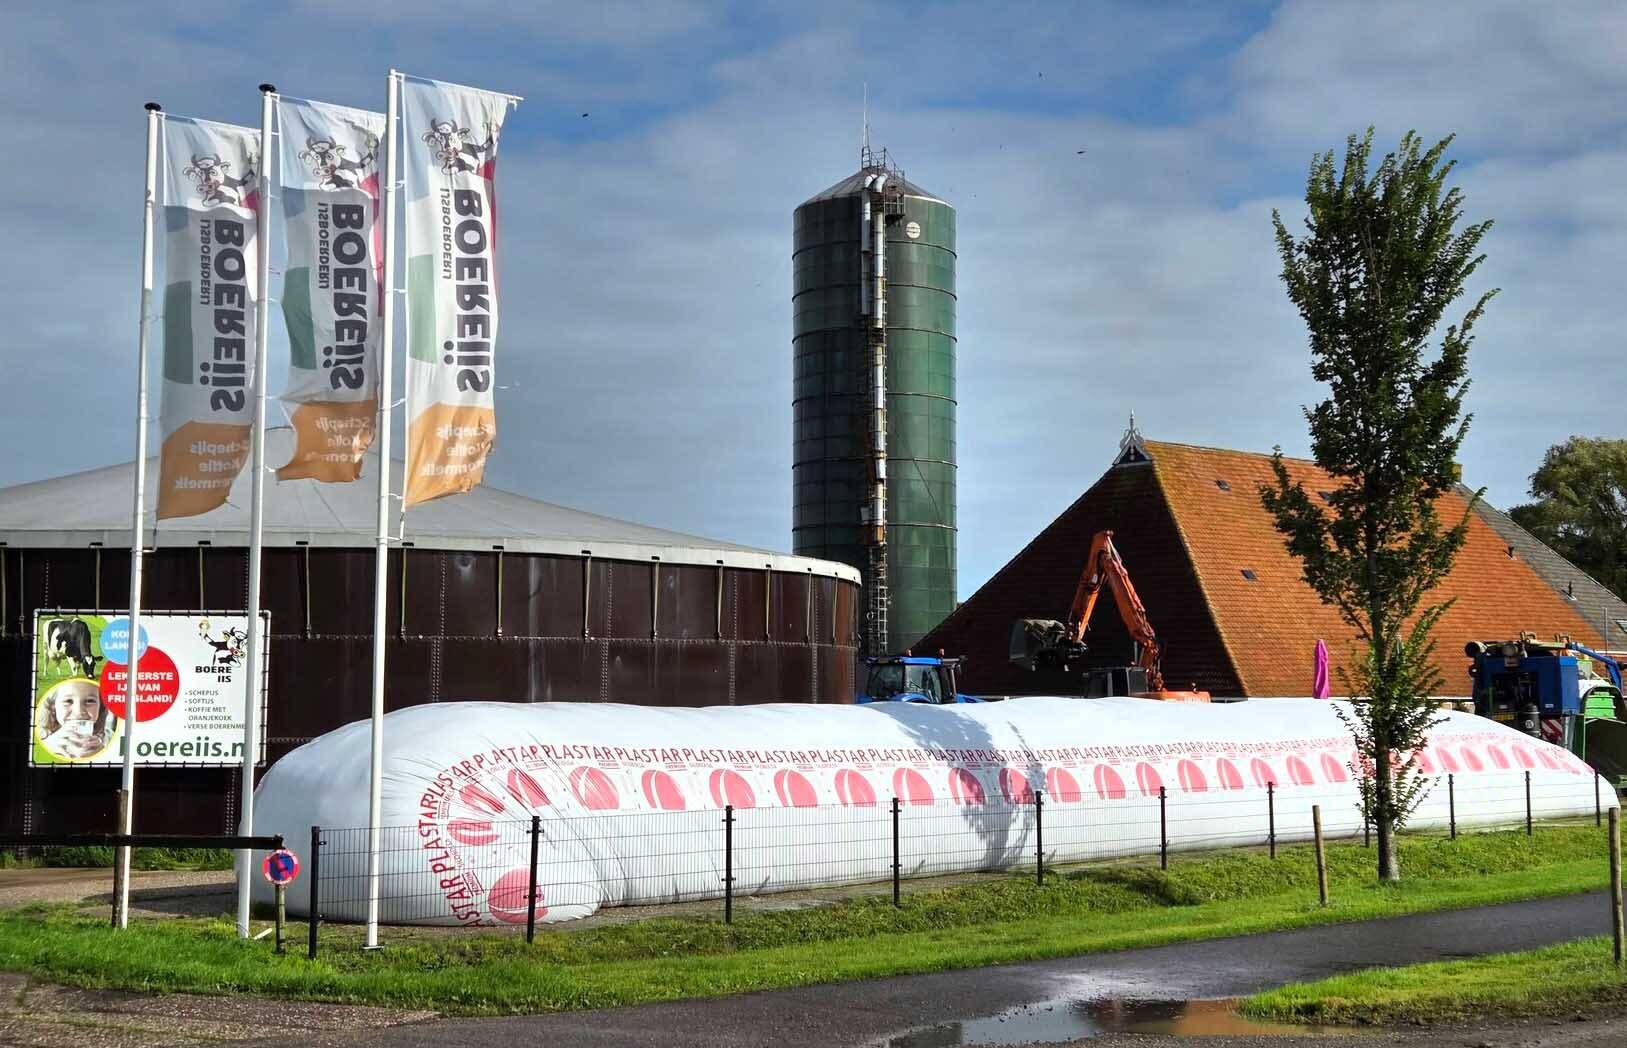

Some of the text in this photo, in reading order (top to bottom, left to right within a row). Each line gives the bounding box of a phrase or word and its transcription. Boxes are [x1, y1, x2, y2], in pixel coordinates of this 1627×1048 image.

[195, 666, 232, 674] BOERE
[108, 672, 173, 681] LEKERSTE
[217, 675, 232, 683] IIS
[138, 683, 161, 691] VAN
[119, 736, 245, 757] oereiis.n
[541, 744, 616, 760] PLASTAR
[614, 747, 683, 763] PLASTAR
[682, 748, 749, 763] PLASTAR
[746, 749, 809, 763] PLASTAR
[808, 749, 869, 763] PLASTAR
[867, 748, 926, 762] PLASTAR
[924, 748, 978, 762] PLASTAR
[976, 748, 1026, 762] PLASTAR
[1024, 748, 1075, 762] PLASTAR
[1071, 746, 1117, 761] PLASTAR
[1115, 744, 1157, 759] PLASTAR
